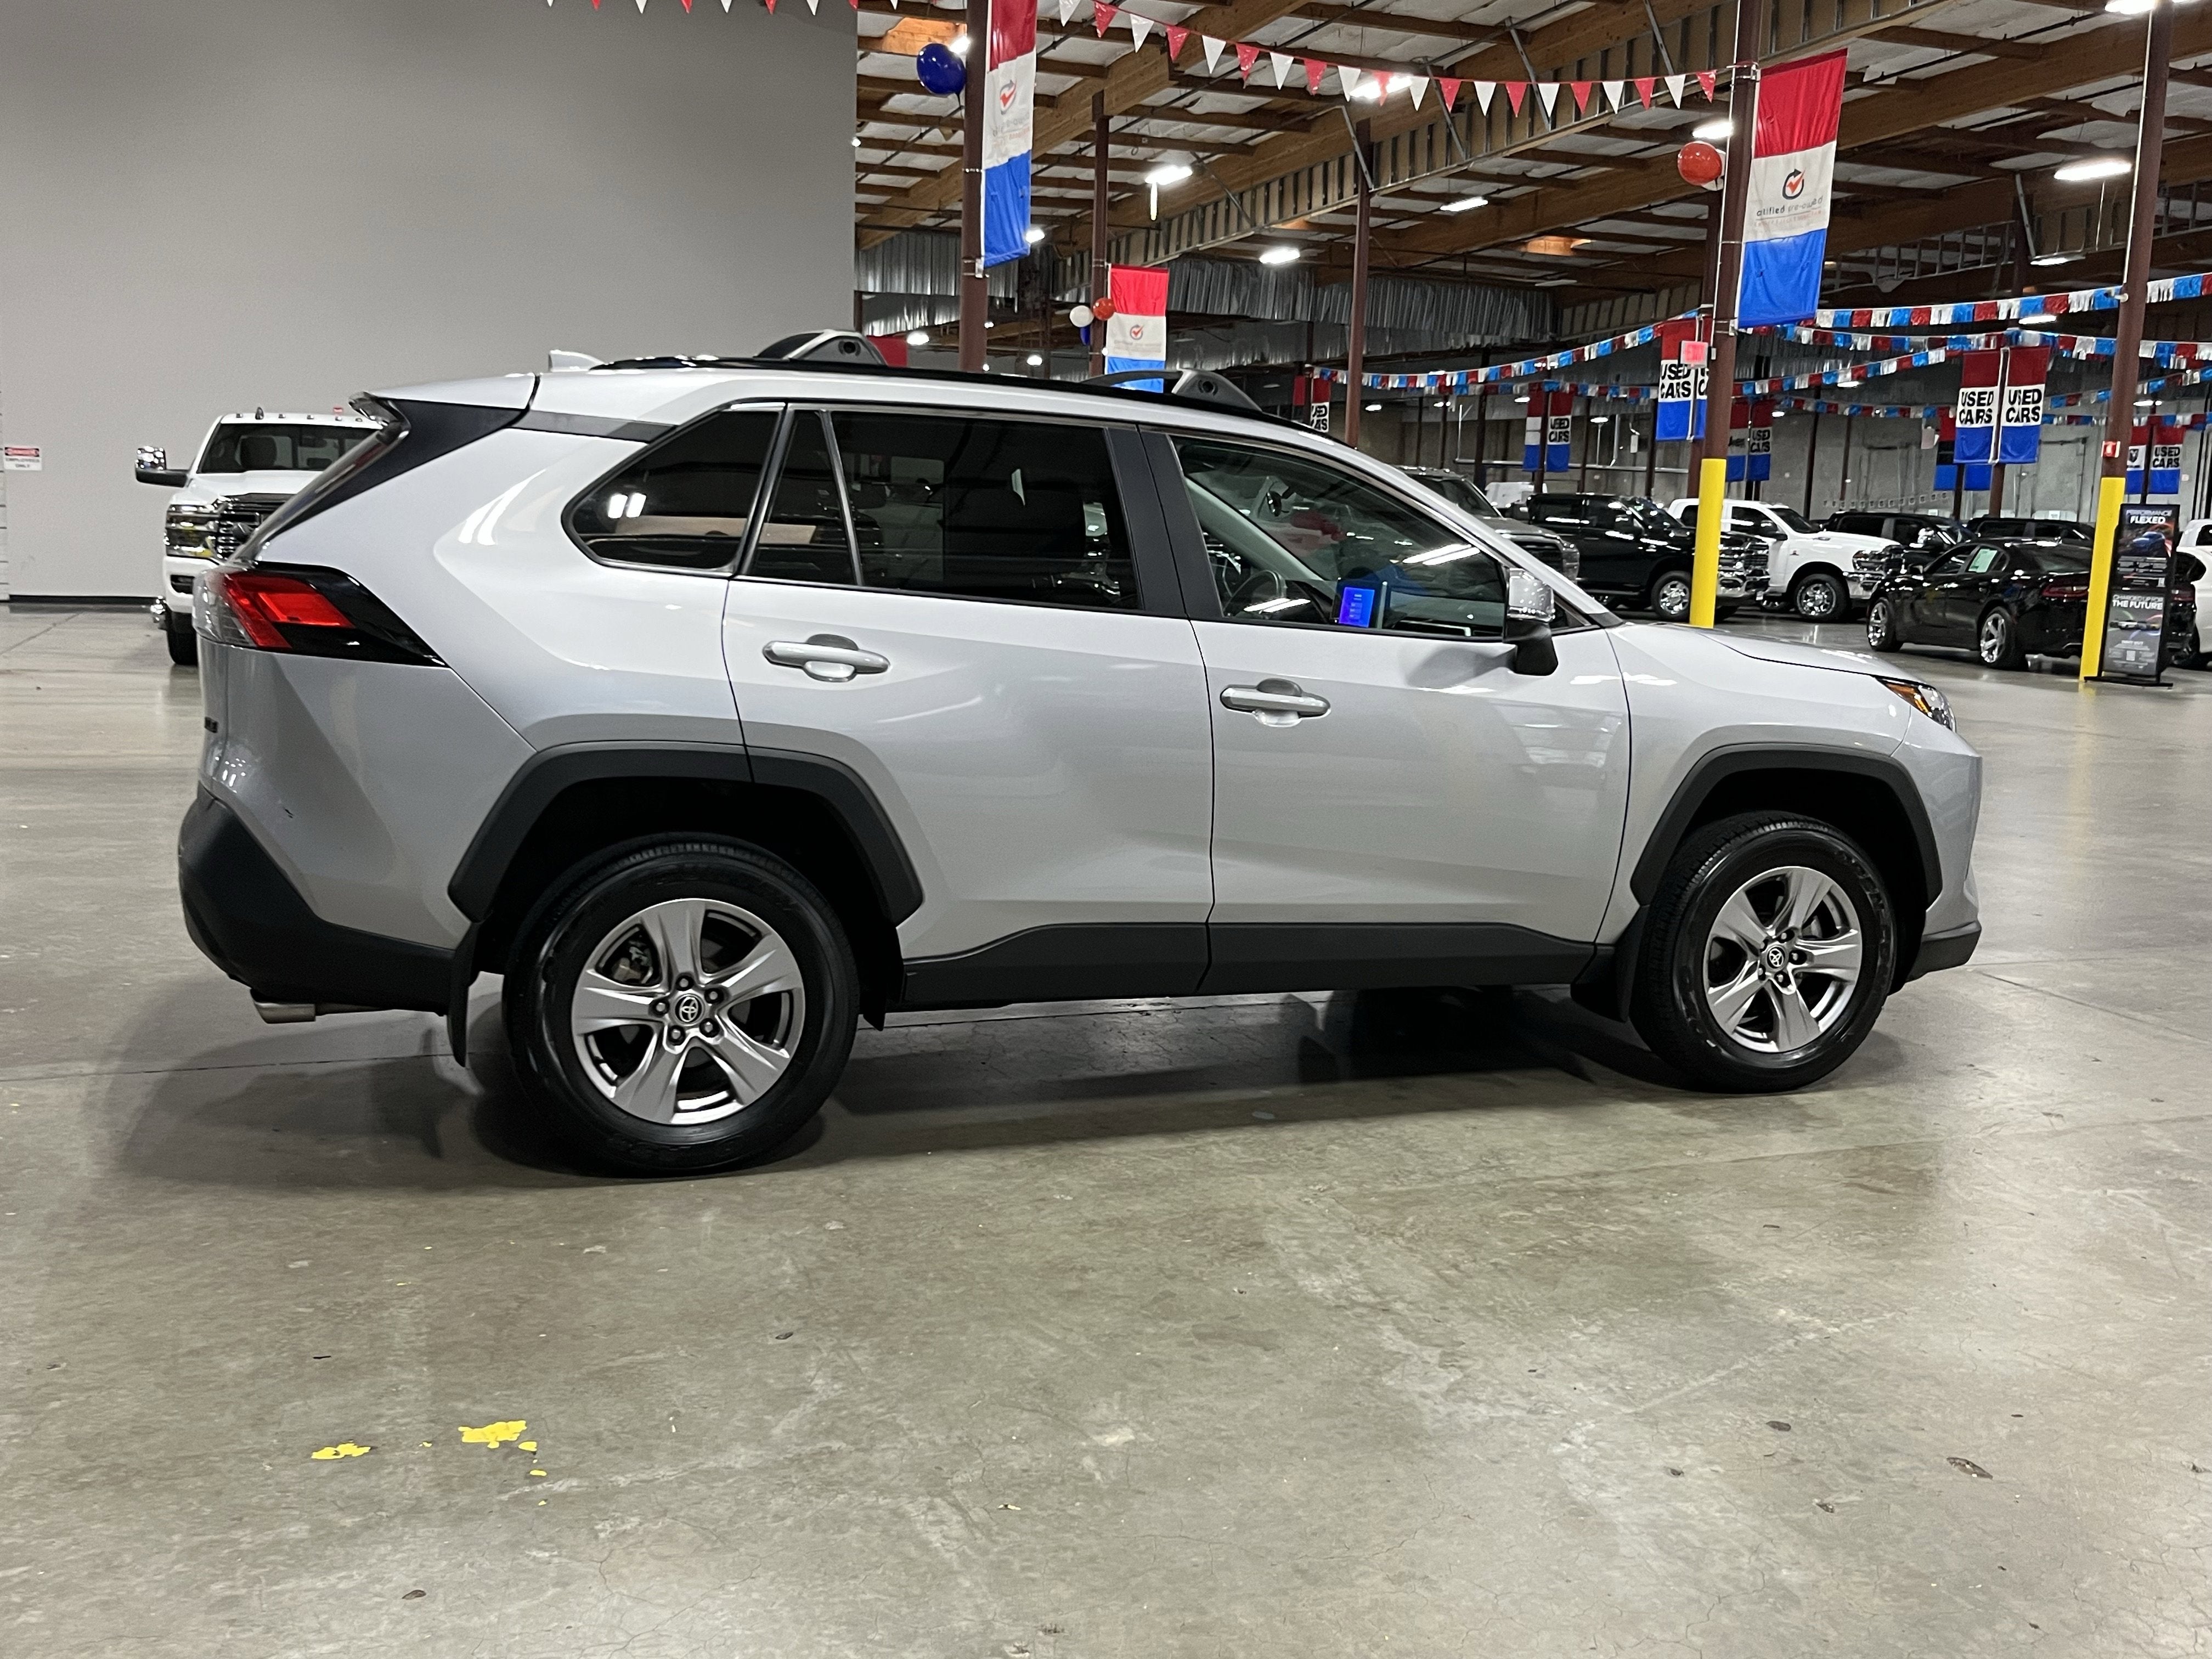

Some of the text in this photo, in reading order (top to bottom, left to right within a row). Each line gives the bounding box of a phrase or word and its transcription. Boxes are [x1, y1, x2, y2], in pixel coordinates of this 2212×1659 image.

[1961, 391, 1994, 407] USED
[2008, 389, 2042, 405] USED
[1959, 408, 1993, 425] CARS
[2006, 406, 2041, 422] CARS
[2154, 447, 2181, 456] USED
[2153, 458, 2180, 468] CARS
[2130, 516, 2166, 524] FLEXED
[2130, 601, 2164, 610] FUTURE
